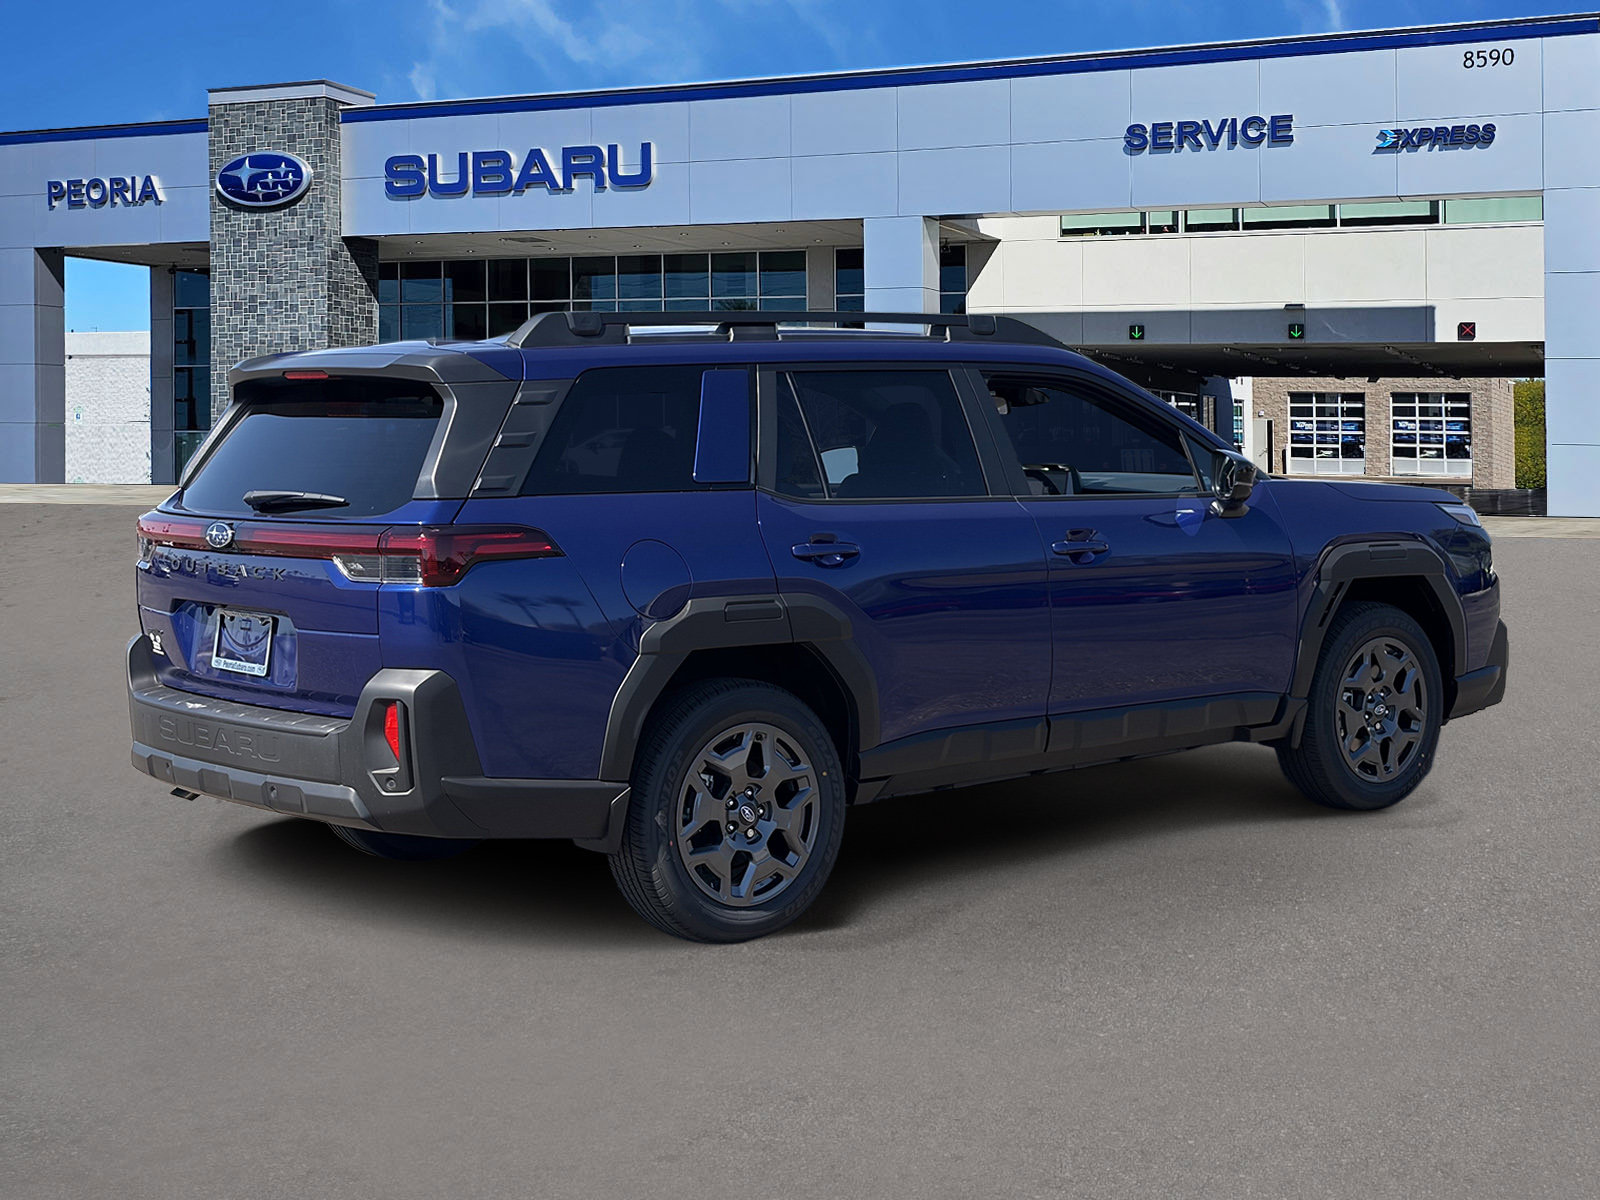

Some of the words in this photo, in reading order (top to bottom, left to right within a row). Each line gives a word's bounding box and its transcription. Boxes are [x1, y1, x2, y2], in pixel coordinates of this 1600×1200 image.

[1463, 48, 1515, 70] 8590
[1124, 114, 1294, 151] SERVICE
[1376, 123, 1496, 151] EXPRESS
[385, 142, 653, 198] SUBARU
[47, 174, 163, 208] PEORIA
[170, 557, 287, 582] OUTBACK
[158, 713, 281, 763] SUBARU
